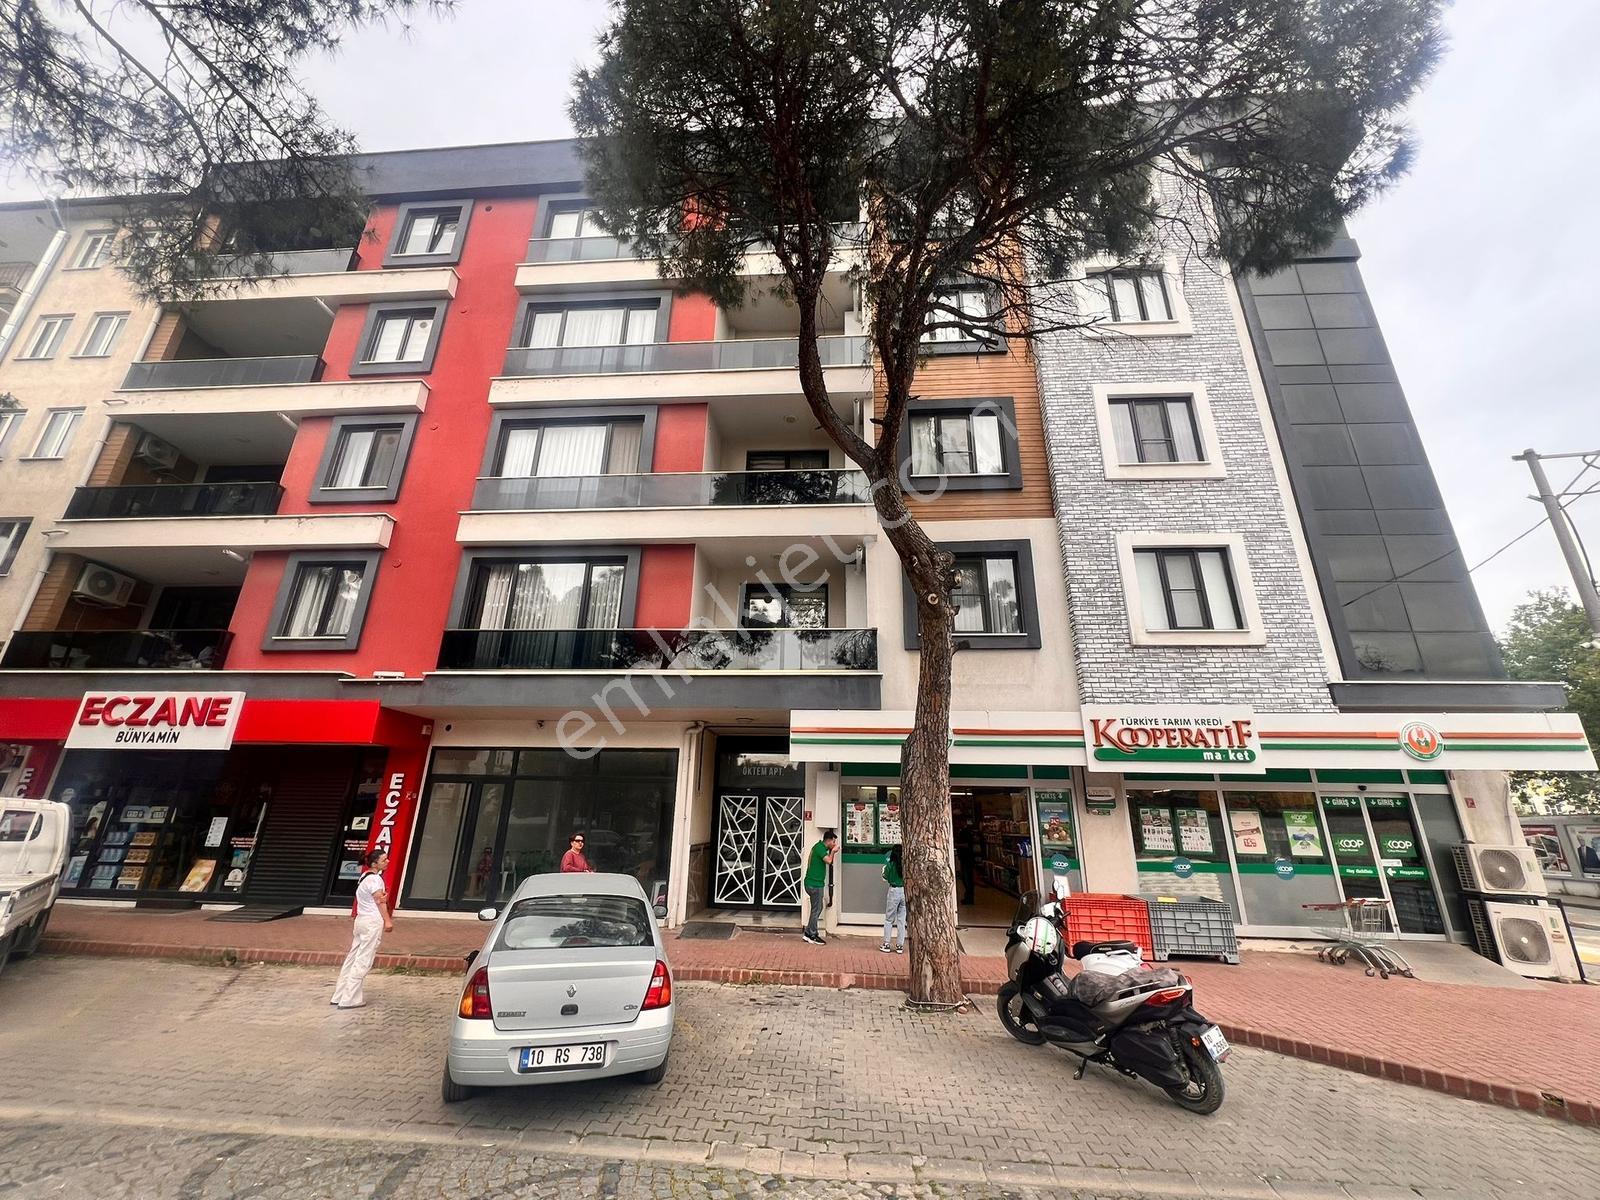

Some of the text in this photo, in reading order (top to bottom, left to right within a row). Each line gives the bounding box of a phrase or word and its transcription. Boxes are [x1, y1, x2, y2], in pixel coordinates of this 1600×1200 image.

[78, 696, 233, 727] ECZANE
[1120, 716, 1223, 726] TÜRKİYE TARIM KREDİ
[115, 728, 181, 744] BÜNYAMİN
[1090, 718, 1252, 753] KOOPERATİF
[1203, 750, 1250, 761] maket
[1338, 839, 1364, 849] KOOP
[1386, 839, 1413, 850] KOOP
[531, 1046, 603, 1065] 10 RS 738
